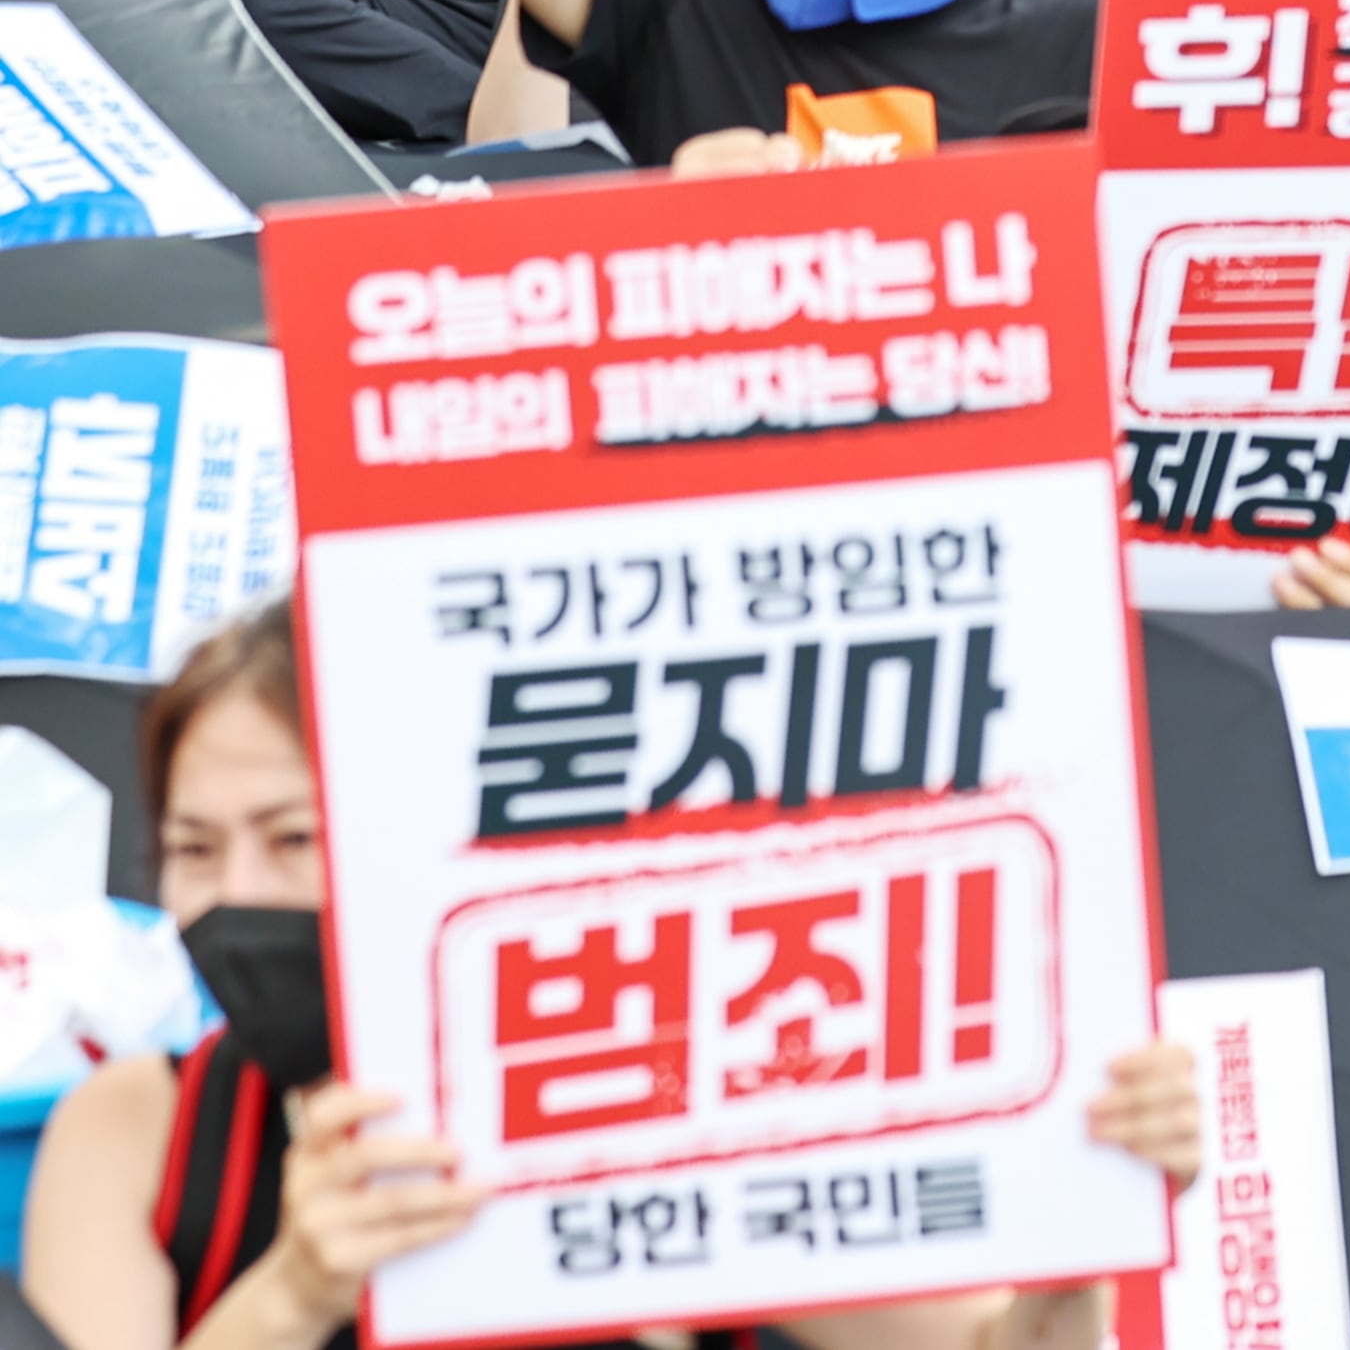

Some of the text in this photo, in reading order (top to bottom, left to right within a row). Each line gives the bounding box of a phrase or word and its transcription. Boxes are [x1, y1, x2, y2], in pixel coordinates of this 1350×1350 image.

[1132, 4, 1309, 134] 후!
[347, 214, 1035, 364] 오늘의 피해자는 나
[353, 368, 571, 465] 내일의
[592, 343, 878, 445] 피해자는
[26, 392, 161, 625] 소비자
[432, 522, 1004, 644] 국가가 방임한
[474, 620, 1009, 840] 묻지마
[495, 866, 997, 1144] 범죄!
[547, 1155, 988, 1275] 당한 국민들
[1216, 1169, 1284, 1350] 희생양
